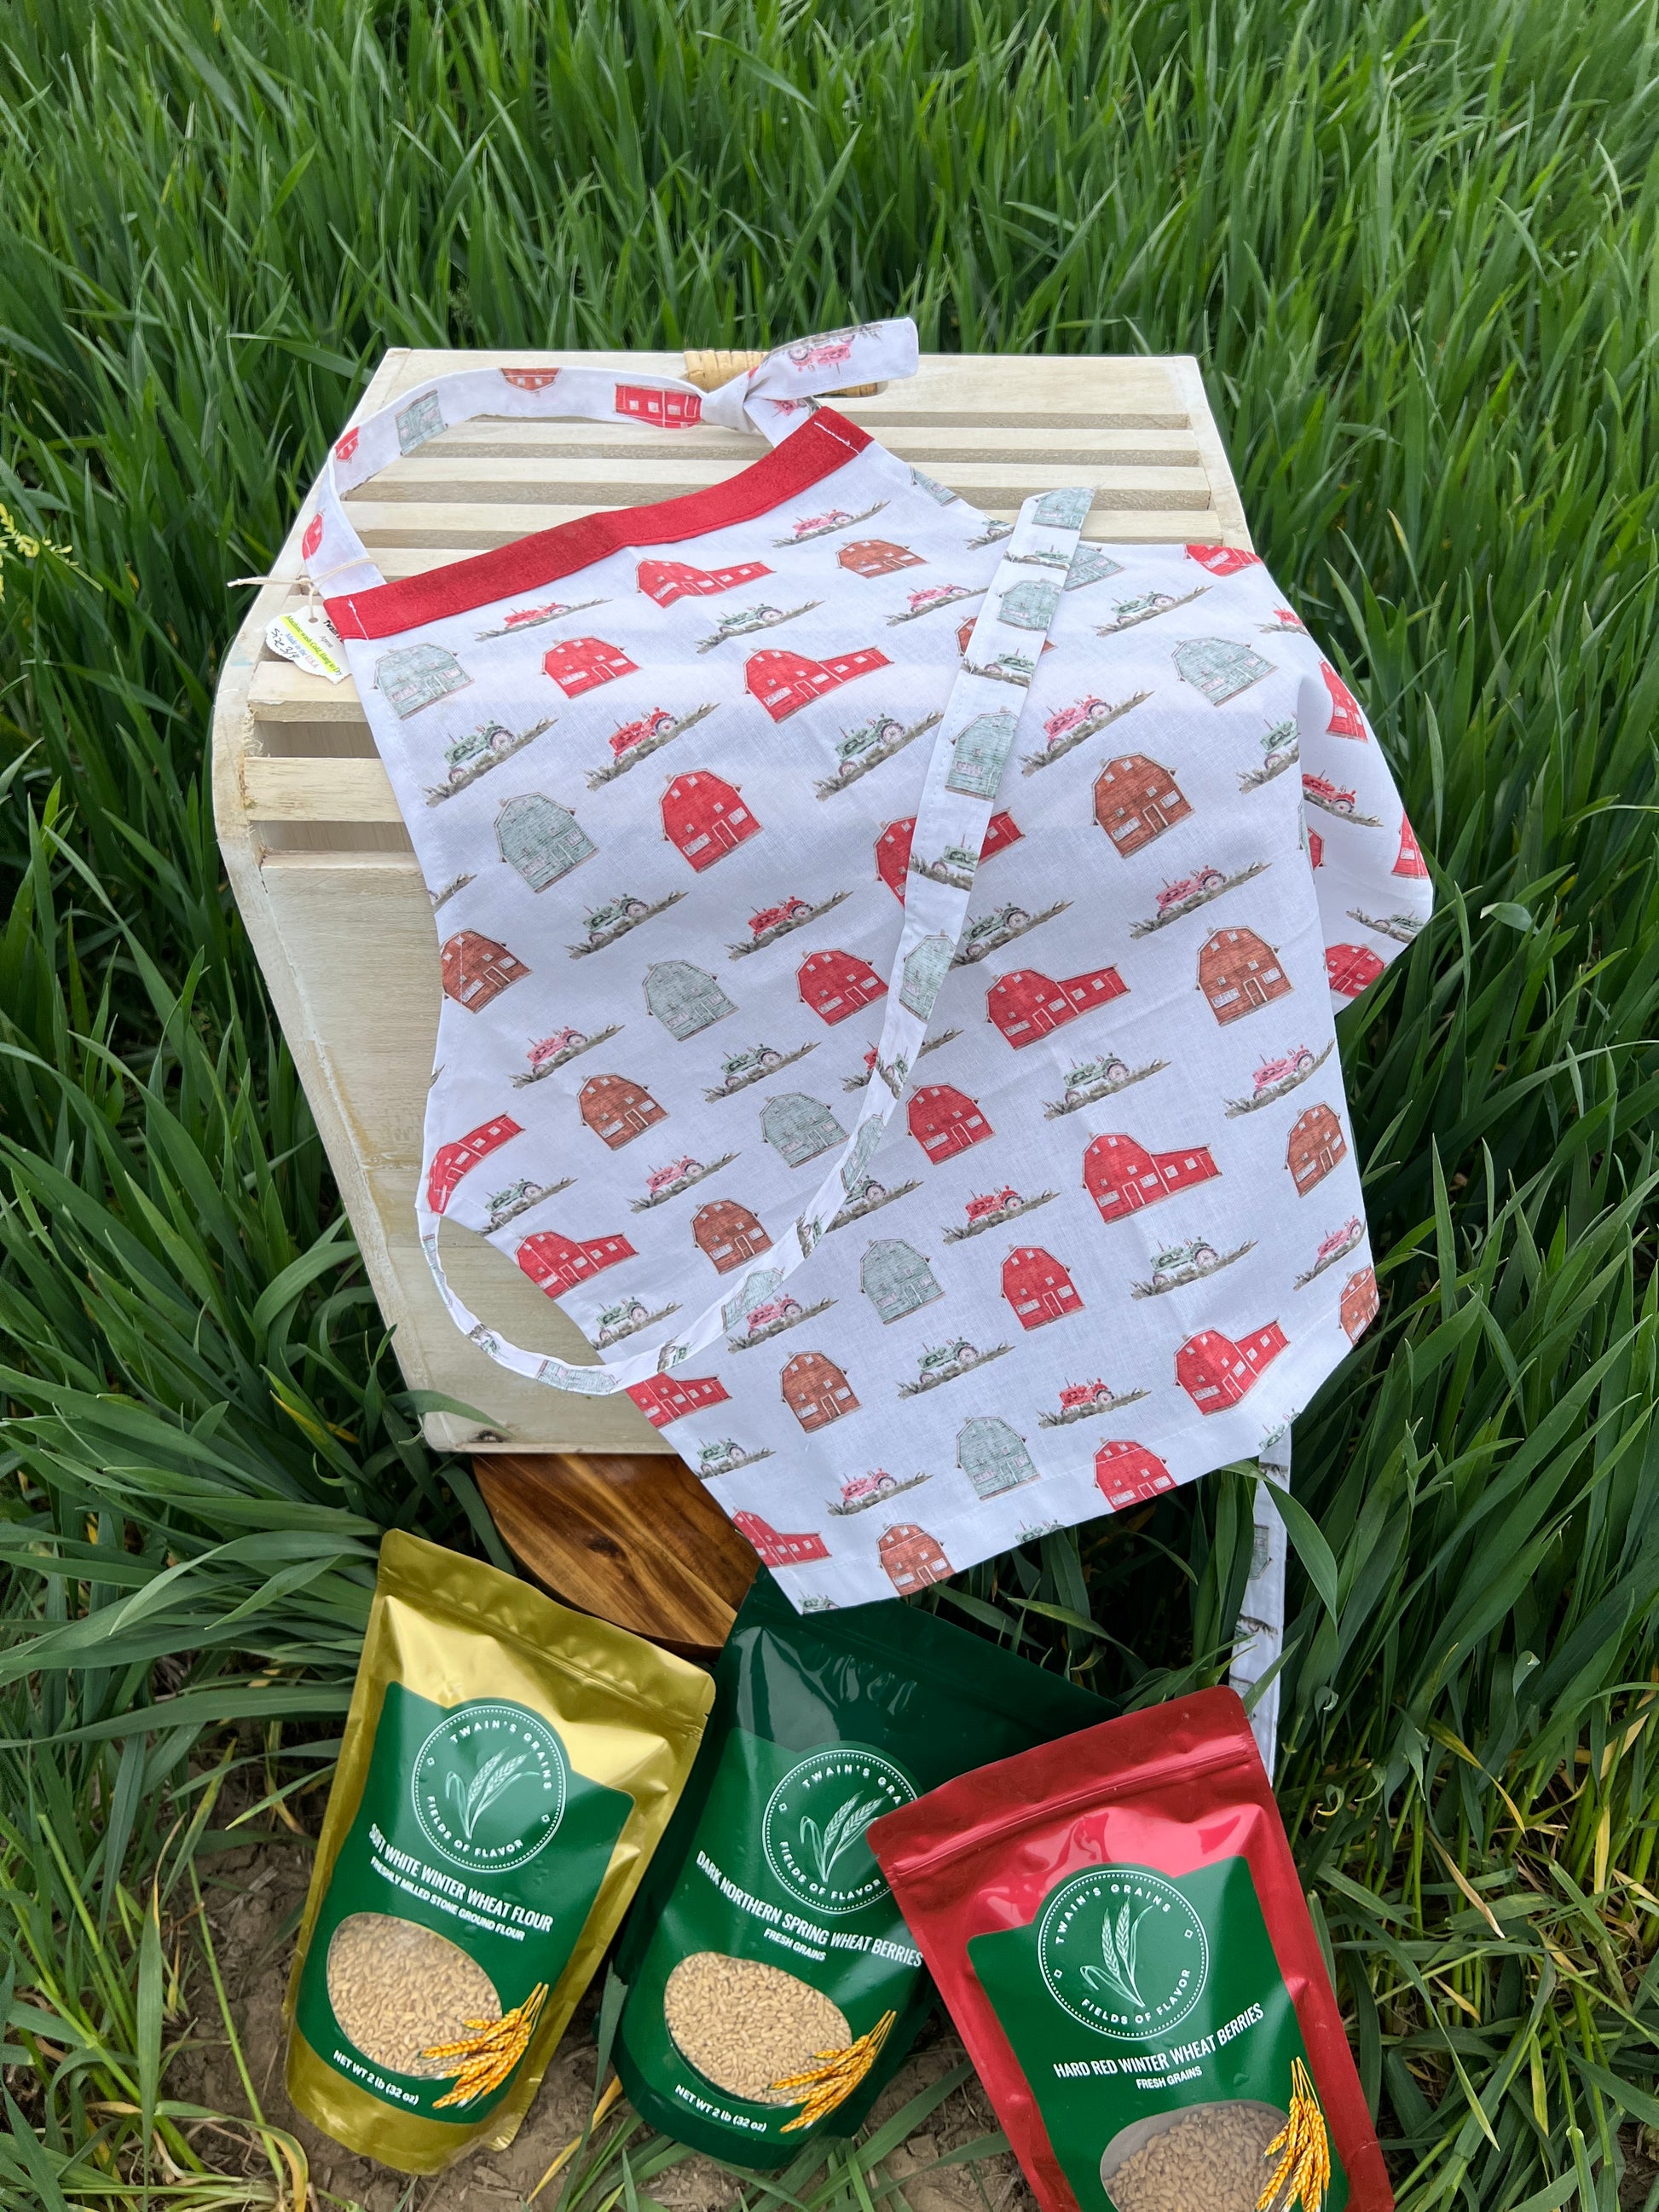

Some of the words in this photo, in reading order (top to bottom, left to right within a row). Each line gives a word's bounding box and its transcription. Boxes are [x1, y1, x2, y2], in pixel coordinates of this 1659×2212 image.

[271, 627, 285, 648] Size
[323, 619, 341, 639] Twains
[449, 1719, 517, 1745] TWAIN'S
[523, 1732, 552, 1790] GRAINS
[802, 1764, 870, 1788] TWAIN'S
[878, 1777, 902, 1805] GRA
[427, 1795, 452, 1839] FIELDS
[454, 1839, 471, 1853] OF
[474, 1839, 523, 1858] FLAVOR
[370, 1856, 402, 1886] FRESHLY
[399, 1878, 431, 1902] MILLED
[429, 1892, 460, 1915] STONE
[458, 1908, 496, 1931] GROUND
[494, 1923, 526, 1942] FLOUR
[384, 1844, 422, 1877] WHITE
[421, 1864, 467, 1901] WINTER
[467, 1887, 512, 1918] WHEAT
[512, 1905, 554, 1932] FLOUR
[780, 1841, 806, 1883] FIELDS
[809, 1882, 826, 1896] OF
[830, 1879, 881, 1900] FLAVOR
[696, 1850, 722, 1886] DARK
[720, 1876, 783, 1924] NORTHERN
[782, 1913, 830, 1945] SPRING
[830, 1932, 872, 1952] WHEAT
[871, 1938, 923, 1967] BERRIES
[1055, 1886, 1101, 1944] TWAIN'S
[1110, 1884, 1171, 1913] GRAINS
[764, 1927, 793, 1948] FRESH
[793, 1941, 826, 1961] GRAINS
[1081, 1998, 1128, 2024] FIELDS
[1135, 2012, 1152, 2024] OF
[1156, 1968, 1190, 2016] FLAVOR
[1053, 2061, 1090, 2078] HARD
[1090, 2059, 1118, 2076] RED
[1118, 2053, 1170, 2074] WINTER
[1169, 2034, 1217, 2065] WHEAT
[1216, 2002, 1264, 2047] BERRIES
[333, 2049, 353, 2069] NET
[352, 2062, 368, 2079] WT
[367, 2072, 375, 2084] 2
[374, 2076, 385, 2090] lb
[385, 2082, 402, 2099] (32
[402, 2093, 419, 2106] oz)
[1136, 2076, 1166, 2089] FRESH
[1166, 2065, 1203, 2086] GRAINS
[674, 2084, 697, 2104] NET
[695, 2098, 713, 2114] WT
[712, 2108, 720, 2117] 2
[720, 2110, 732, 2122] lb
[732, 2115, 750, 2128] (32
[750, 2122, 767, 2133] oz)
